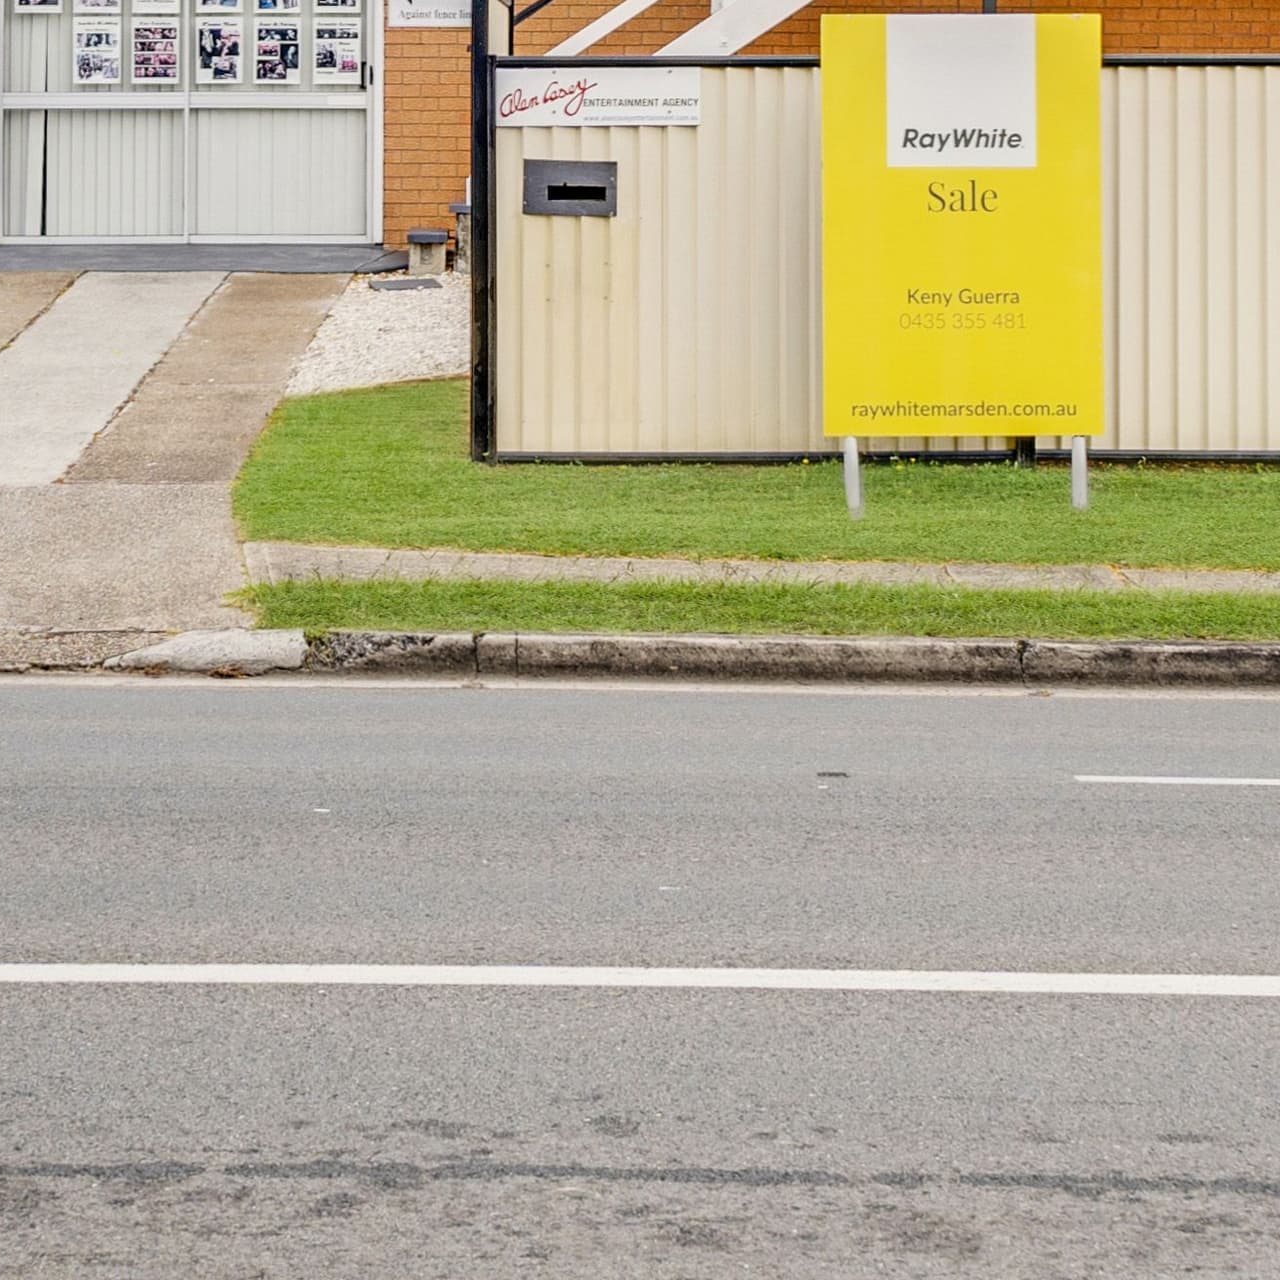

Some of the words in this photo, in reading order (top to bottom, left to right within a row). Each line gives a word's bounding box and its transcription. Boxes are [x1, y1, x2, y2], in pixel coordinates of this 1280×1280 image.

[399, 9, 431, 20] Against
[434, 9, 457, 19] fence
[459, 10, 472, 19] lin
[499, 88, 540, 118] Alan
[583, 97, 659, 108] ENTERTAINMENT
[662, 97, 699, 108] AGENCY
[927, 180, 998, 212] Sale
[907, 289, 952, 307] Keny
[959, 289, 1020, 305] Guerra
[900, 313, 946, 330] 0435
[952, 313, 987, 330] 355
[992, 313, 1026, 330] 481
[851, 402, 1077, 420] raywhitemarsden.com.au
